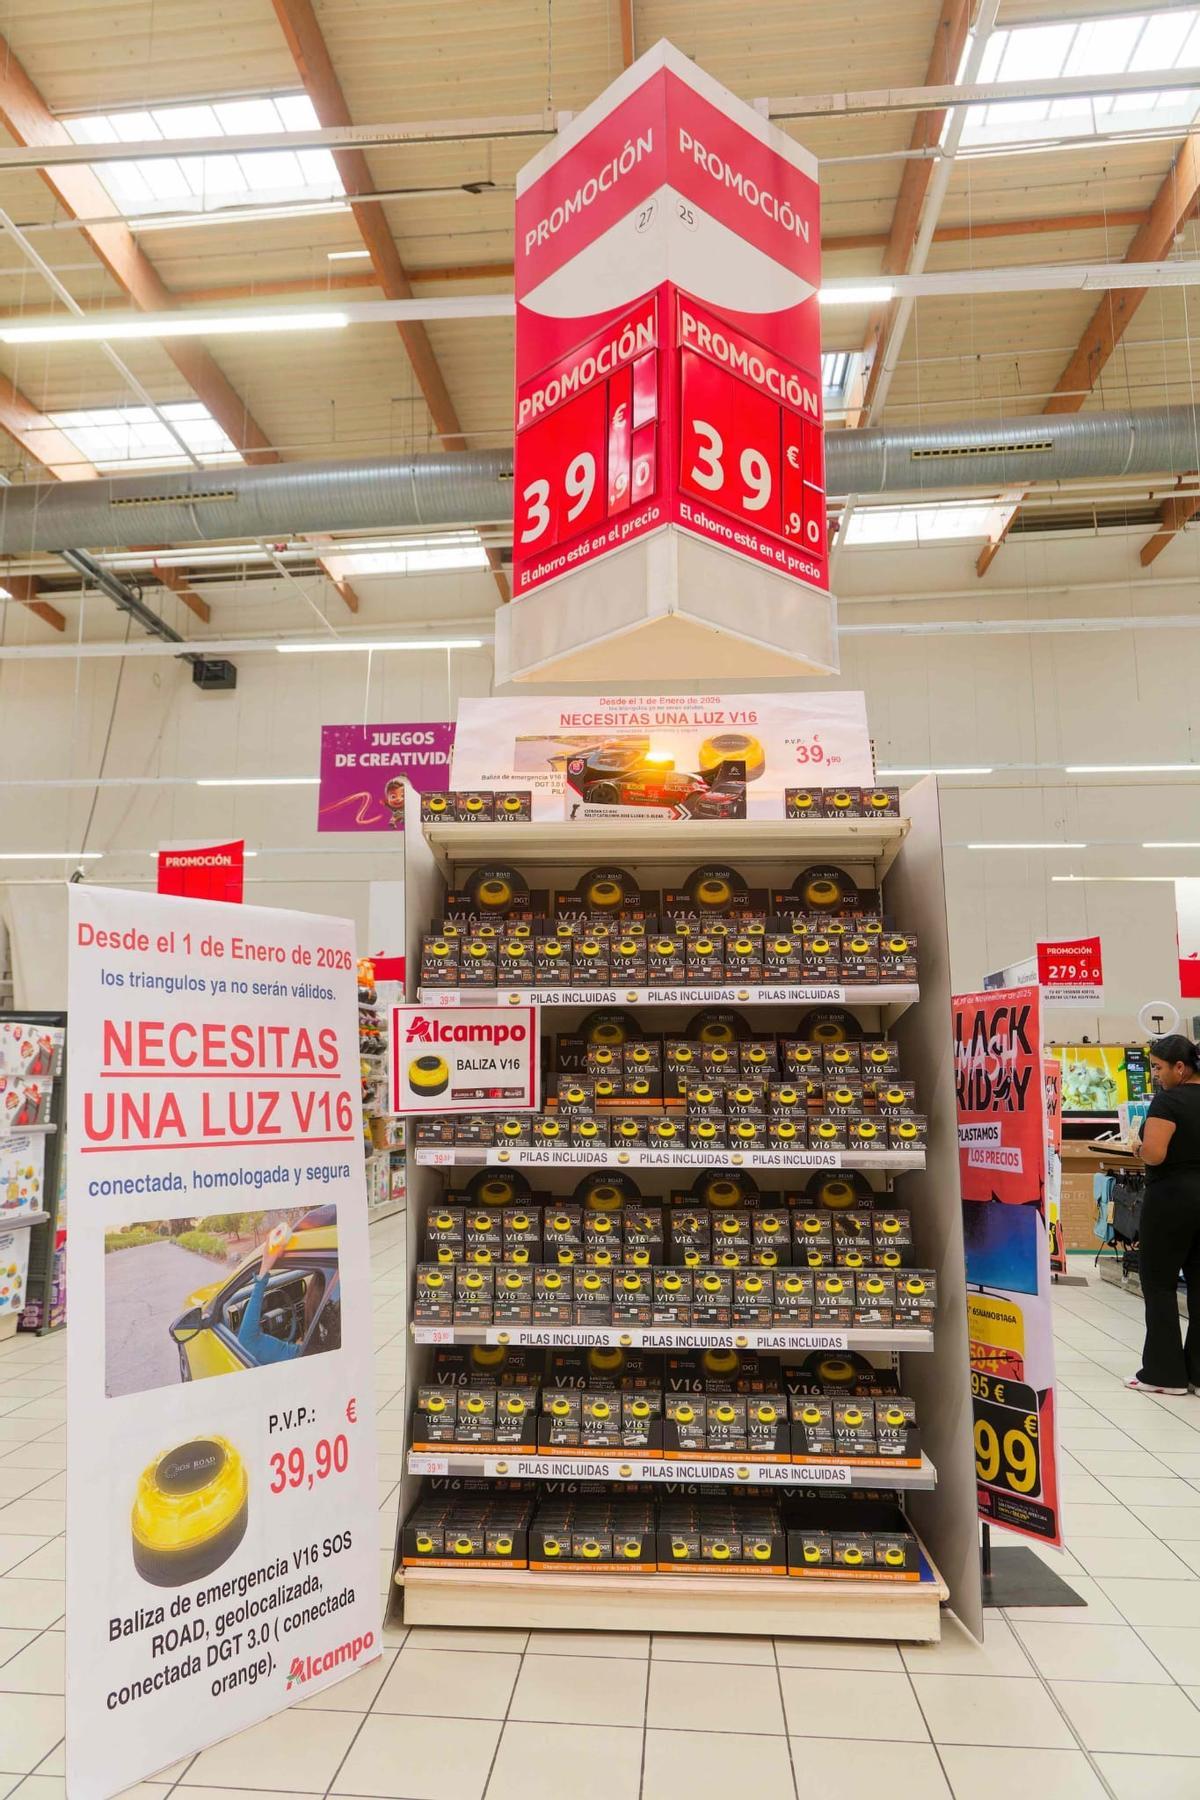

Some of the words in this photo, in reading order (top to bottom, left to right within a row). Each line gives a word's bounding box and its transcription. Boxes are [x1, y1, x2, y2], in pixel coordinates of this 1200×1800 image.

[525, 127, 653, 256] PROMOCIÓN
[679, 128, 810, 243] PROMOCIÓN
[638, 205, 654, 229] 27
[679, 204, 695, 226] 25
[681, 310, 818, 418] PROMOCIÓN
[517, 315, 653, 430] PROMOCIÓN
[691, 420, 772, 511] 39
[520, 452, 596, 544] 39
[521, 568, 531, 587] El
[531, 555, 566, 581] ahorro
[567, 539, 592, 563] está
[592, 535, 606, 550] en
[608, 525, 621, 541] el
[622, 506, 660, 540] precio
[680, 503, 693, 520] El
[694, 508, 733, 539] ahorro
[734, 526, 758, 550] está
[760, 541, 774, 556] en
[775, 545, 787, 564] el
[788, 555, 821, 580] precio
[599, 697, 626, 706] Desde
[629, 697, 637, 706] el
[646, 697, 657, 705] de
[659, 696, 685, 705] Enero
[687, 696, 698, 705] de
[700, 696, 721, 704] 2026
[560, 712, 650, 726] NECESITAS
[655, 712, 689, 725] UNA
[694, 711, 724, 725] LUZ
[729, 711, 757, 723] V16
[371, 731, 435, 746] JUEGOS
[335, 753, 357, 767] DE
[423, 814, 440, 822] V16
[497, 814, 514, 822] V16
[865, 809, 882, 817] V16
[165, 853, 232, 867] PROMOCIÓN
[77, 922, 149, 952] Desde
[156, 932, 175, 954] el
[182, 934, 191, 955] 1
[200, 936, 224, 957] de
[231, 937, 286, 965] Enero
[291, 944, 312, 966] de
[317, 947, 352, 970] 2026
[1046, 946, 1093, 955] PROMOCIÓN
[426, 959, 442, 967] V16
[575, 959, 593, 967] V16
[806, 956, 823, 964] V16
[1048, 965, 1077, 979] 279
[100, 968, 125, 987] los
[129, 971, 206, 995] triangulos
[210, 979, 227, 995] ya
[231, 981, 248, 994] no
[252, 977, 288, 997] serán
[291, 982, 336, 1000] válidos.
[531, 993, 560, 1004] PILAS
[562, 992, 617, 1004] INCLUIDAS
[648, 992, 676, 1003] PILAS
[679, 990, 735, 1001] INCLUIDAS
[758, 990, 786, 1000] PILAS
[788, 989, 840, 1000] INCLUIDAS
[406, 1016, 526, 1046] Alcampo
[955, 1004, 1033, 1058] LACK
[103, 1019, 340, 1069] NECESITAS
[456, 1058, 497, 1071] BALIZA
[500, 1058, 520, 1070] V16
[589, 1066, 606, 1074] V16
[955, 1066, 1033, 1113] RIDAY
[84, 1092, 187, 1142] UNA
[203, 1091, 281, 1137] LUZ
[291, 1090, 353, 1133] V16
[689, 1105, 707, 1114] V16
[958, 1126, 999, 1142] PLASTAMOS
[892, 1141, 910, 1150] V16
[519, 1152, 549, 1163] PILAS
[552, 1152, 608, 1163] INCLUIDAS
[640, 1153, 670, 1164] PILAS
[672, 1153, 729, 1165] INCLUIDAS
[752, 1154, 781, 1165] PILAS
[783, 1154, 836, 1165] INCLUIDAS
[970, 1150, 985, 1163] LOS
[985, 1151, 1020, 1167] PRECIOS
[88, 1172, 188, 1198] conectada,
[192, 1164, 290, 1191] homologada
[294, 1168, 302, 1185] y
[306, 1163, 350, 1183] segura
[429, 1232, 446, 1240] V16
[419, 1290, 437, 1298] V16
[738, 1295, 756, 1304] V16
[519, 1333, 550, 1344] PILAS
[552, 1334, 609, 1346] INCLUIDAS
[642, 1335, 673, 1347] PILAS
[675, 1335, 733, 1347] INCLUIDAS
[756, 1337, 786, 1348] PILAS
[788, 1337, 842, 1348] INCLUIDAS
[437, 1372, 467, 1385] V16
[555, 1376, 586, 1389] V16
[670, 1379, 702, 1392] V16
[787, 1384, 820, 1395] V16
[994, 1383, 1005, 1403] €
[345, 1398, 358, 1425] €
[268, 1406, 316, 1435] P.V.P.:
[460, 1415, 478, 1424] V16
[1023, 1414, 1038, 1438] €
[880, 1429, 897, 1437] V16
[269, 1434, 350, 1496] 39,90
[518, 1463, 549, 1475] PILAS
[551, 1463, 609, 1476] INCLUIDAS
[642, 1466, 673, 1478] PILAS
[676, 1466, 735, 1478] INCLUIDAS
[759, 1468, 788, 1479] PILAS
[790, 1468, 846, 1480] INCLUIDAS
[109, 1604, 166, 1641] Baliza
[170, 1596, 192, 1618] de
[196, 1558, 289, 1608] emergencia
[293, 1544, 319, 1570] V16
[322, 1530, 353, 1558] SOS
[151, 1618, 210, 1658] ROAD,
[215, 1572, 324, 1638] geolocalizada,
[106, 1655, 202, 1711] conectada
[207, 1638, 241, 1669] DGT
[248, 1624, 271, 1650] 3.0
[283, 1588, 356, 1633] conectada
[286, 1631, 375, 1691] Alcampo
[211, 1651, 277, 1698] orange).
